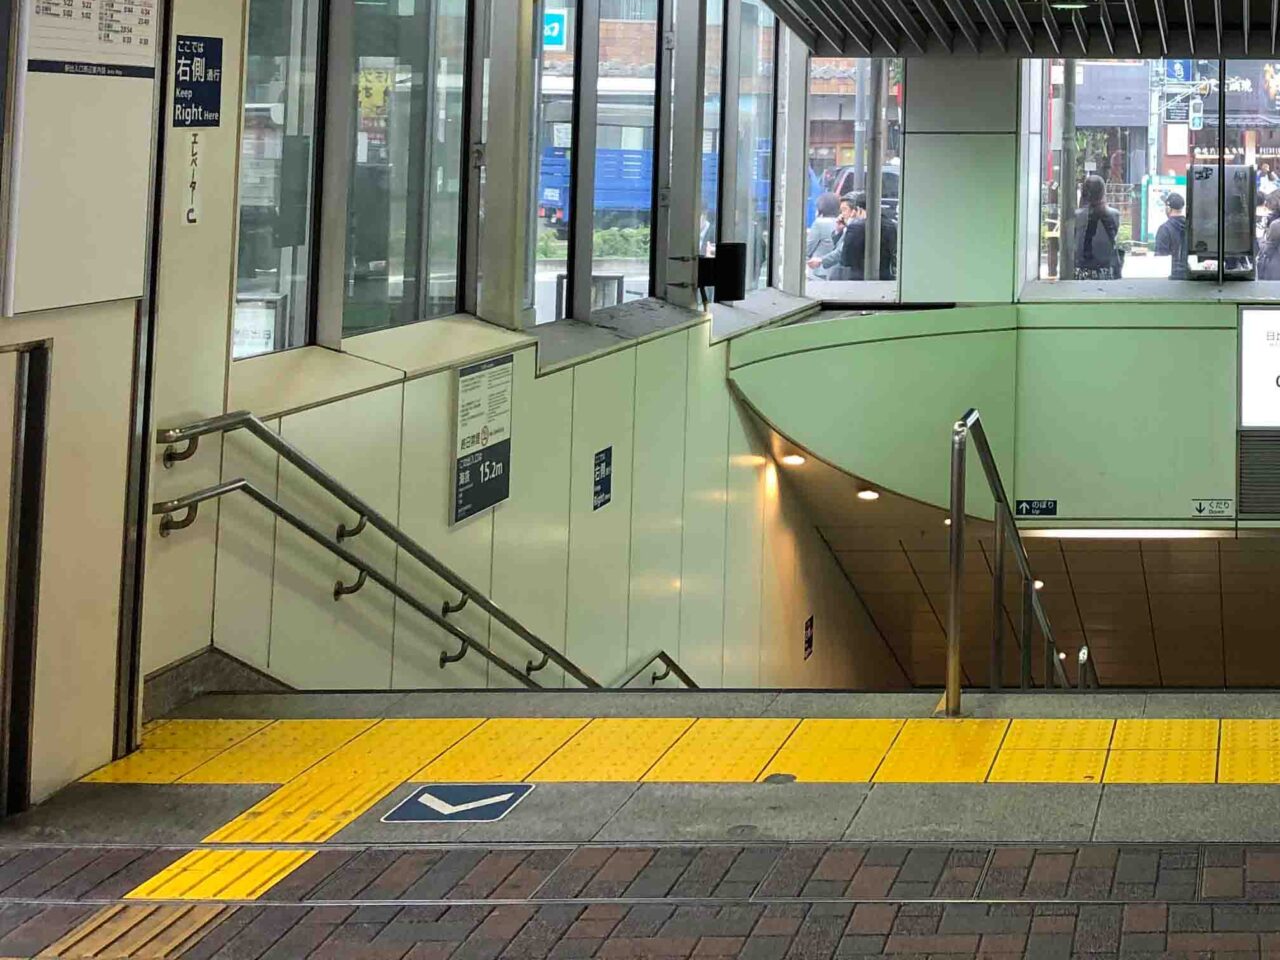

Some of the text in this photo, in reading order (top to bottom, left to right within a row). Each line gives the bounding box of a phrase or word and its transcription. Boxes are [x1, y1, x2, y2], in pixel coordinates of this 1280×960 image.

[177, 40, 204, 53] ここでは
[176, 87, 193, 100] Keep
[175, 103, 219, 125] Right Here
[189, 133, 199, 205] エレベーター
[1208, 501, 1230, 510] くだり
